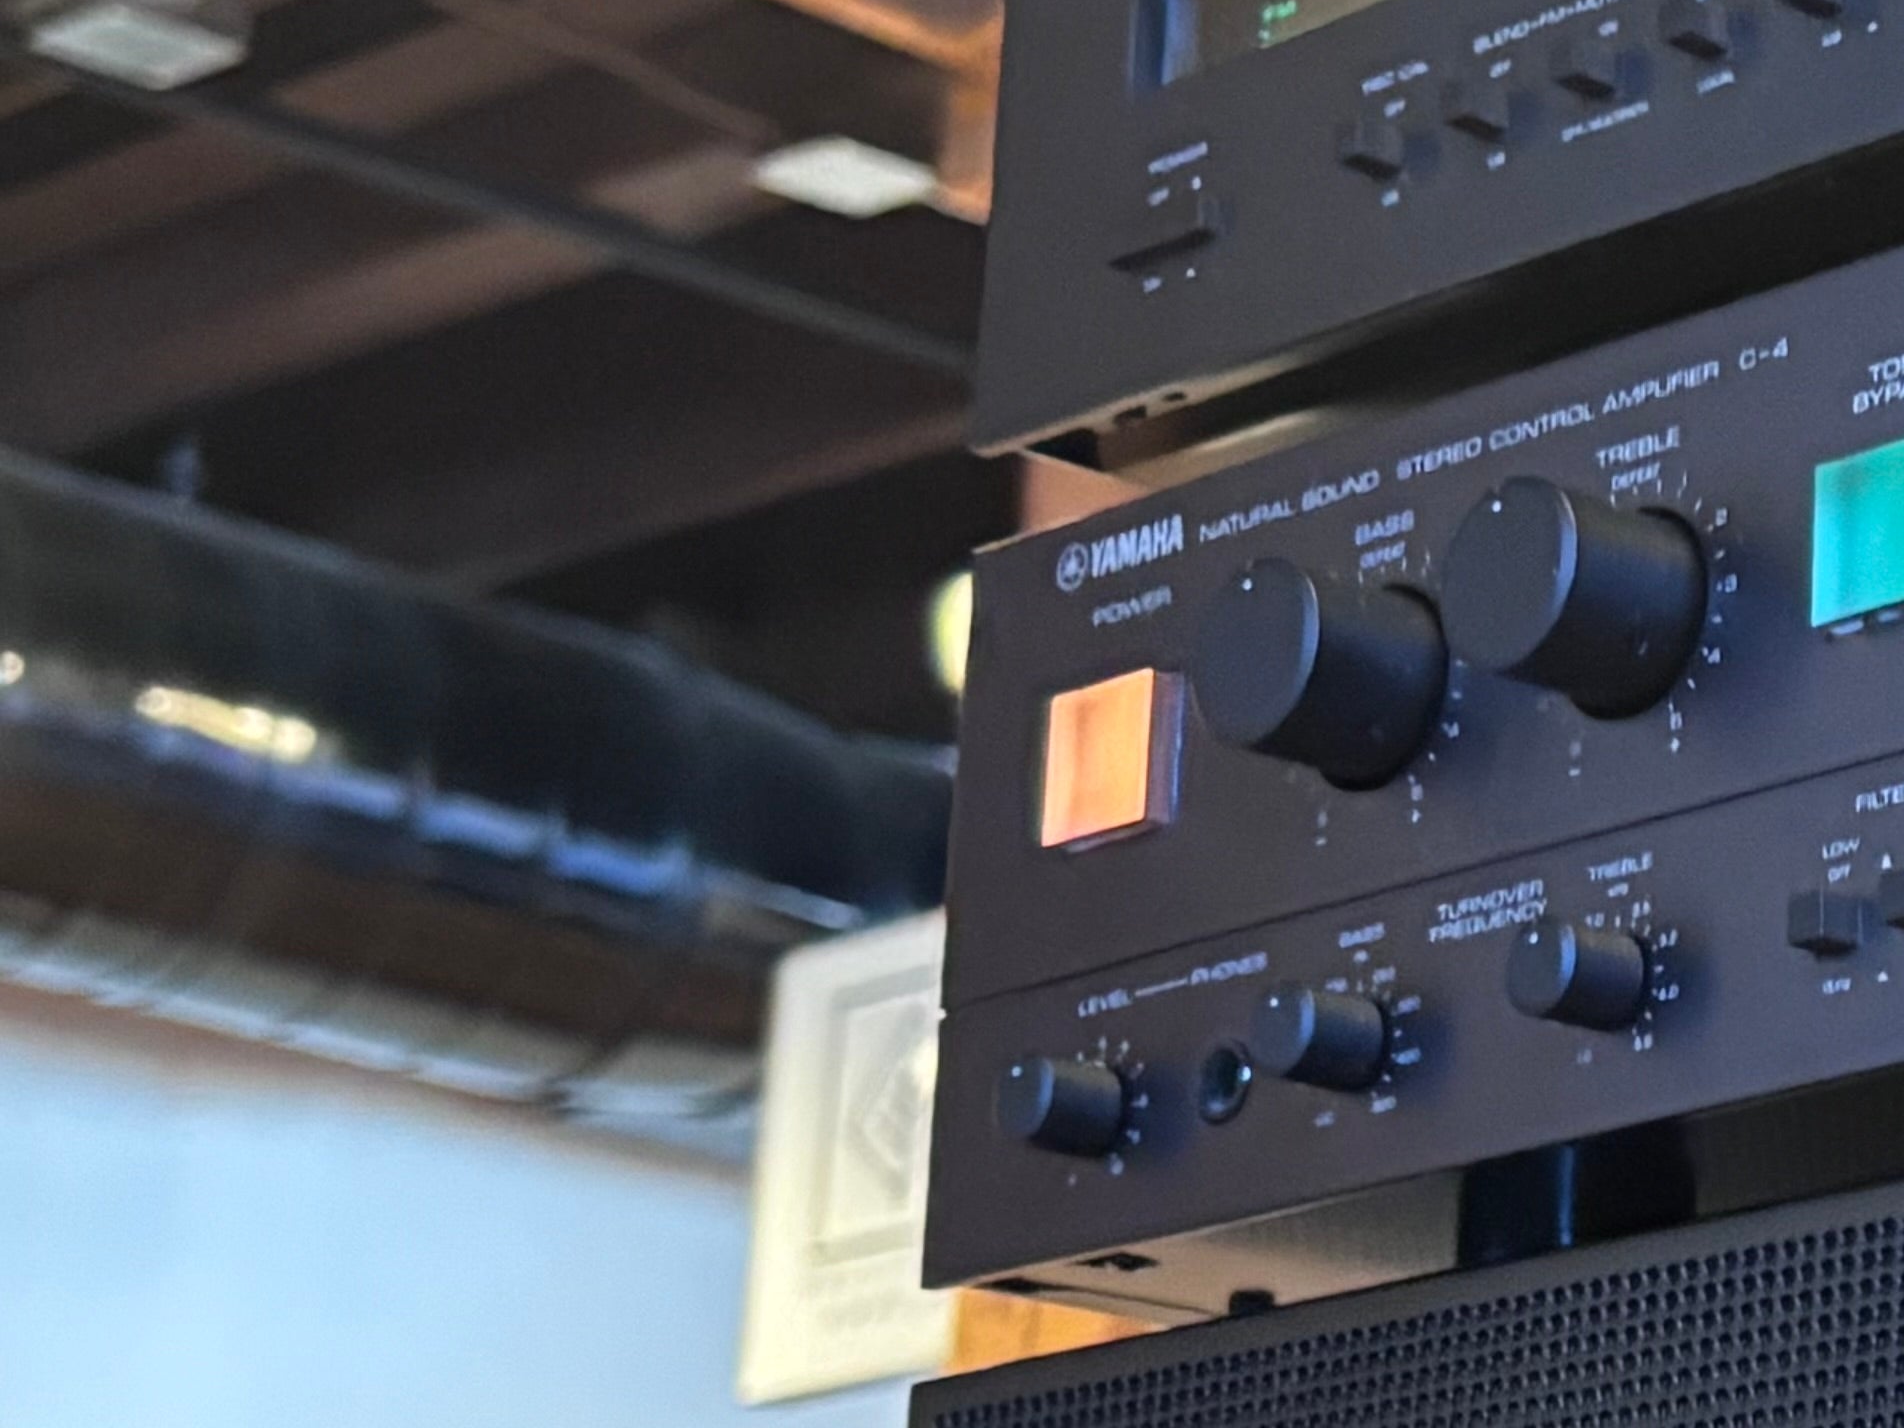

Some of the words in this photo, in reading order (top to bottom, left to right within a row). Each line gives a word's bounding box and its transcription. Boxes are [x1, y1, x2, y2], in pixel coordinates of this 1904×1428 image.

[1088, 514, 1185, 578] YAMAHA
[1200, 497, 1297, 544] NATURAL
[1301, 468, 1381, 515] SOUND
[1396, 434, 1482, 482] STEREO
[1489, 401, 1595, 452] CONTROL
[1602, 359, 1720, 415] AMPLIFIER
[1738, 336, 1790, 372] C-4
[1596, 425, 1681, 468] TREBLE
[1354, 509, 1415, 547] BASS
[1092, 584, 1173, 629] POWER
[1822, 837, 1861, 861] LOW
[1428, 897, 1549, 943] FREQUENCY
[1436, 878, 1544, 922] TURNOVER
